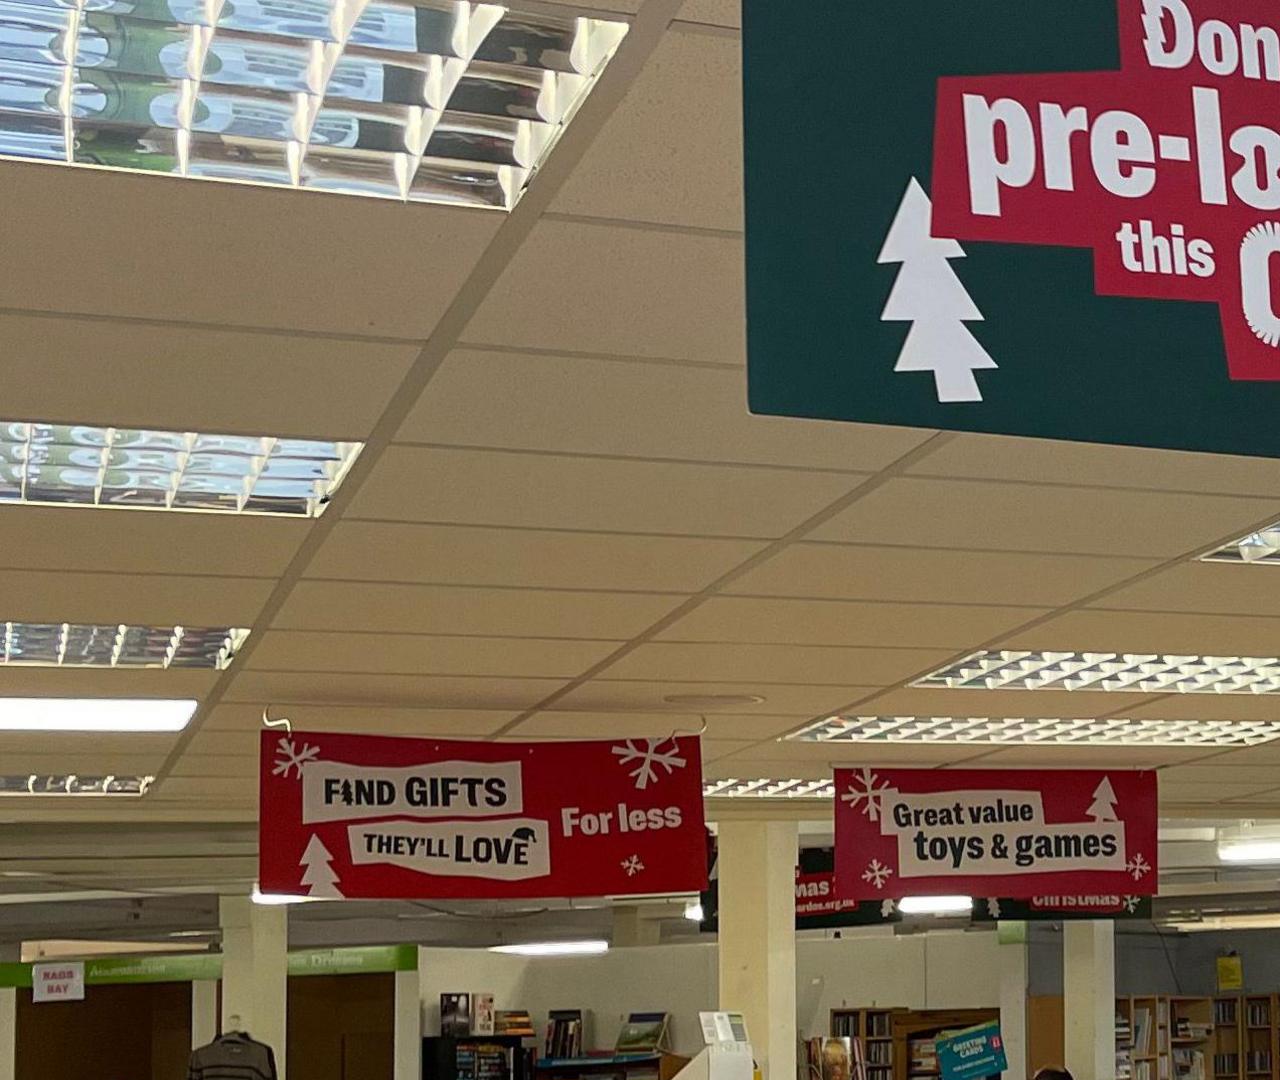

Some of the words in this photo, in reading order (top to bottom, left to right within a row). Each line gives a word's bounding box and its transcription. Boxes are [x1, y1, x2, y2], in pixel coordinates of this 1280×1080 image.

[1117, 220, 1214, 279] this
[405, 776, 508, 807] GIFTS
[561, 806, 610, 837] For
[619, 803, 682, 833] less
[894, 802, 964, 828] Great
[969, 799, 1034, 825] value
[364, 833, 449, 859] THEY'LL
[455, 832, 530, 865] LOVE
[914, 832, 985, 869] toys
[992, 837, 1008, 859] &
[1015, 833, 1118, 867] games
